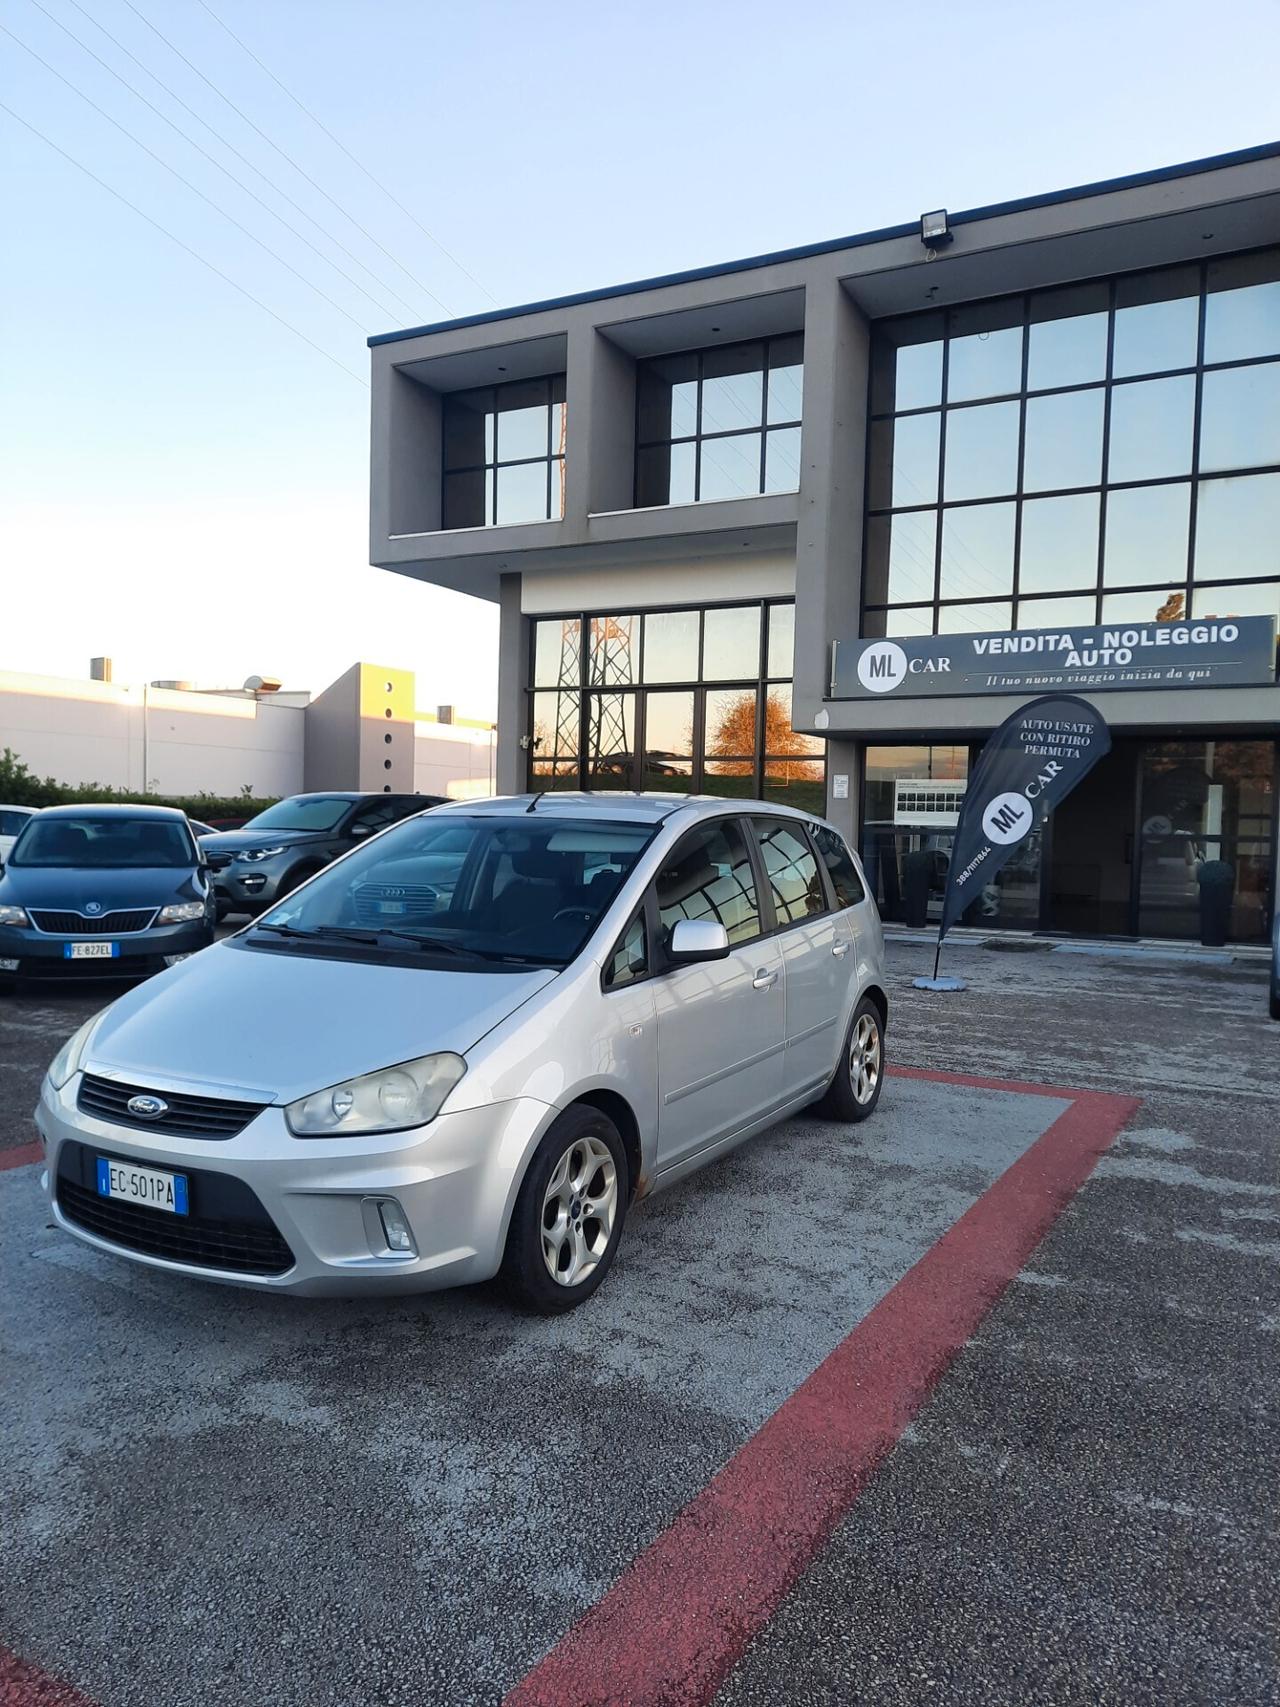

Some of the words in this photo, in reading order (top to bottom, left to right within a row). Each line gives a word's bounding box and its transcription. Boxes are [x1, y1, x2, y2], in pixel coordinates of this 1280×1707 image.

[973, 634, 1075, 655] VENDITA
[1103, 624, 1239, 648] NOLEGGIO
[869, 654, 897, 678] ML
[908, 657, 952, 674] CAR
[1064, 648, 1133, 668] AUTO
[986, 675, 997, 687] Il
[1001, 675, 1021, 686] tuo
[1025, 674, 1063, 686] nuovo
[1067, 671, 1116, 686] viaggio
[1120, 668, 1162, 681] inizia
[1166, 667, 1184, 680] da
[1188, 667, 1212, 680] qui
[1020, 719, 1053, 730] AUTO
[1055, 721, 1095, 734] USATE
[1020, 731, 1045, 742] CON
[1047, 733, 1091, 747] RITIRO
[1024, 744, 1080, 759] PERMUTA
[990, 803, 1025, 835] ML
[1024, 760, 1064, 799] CAR
